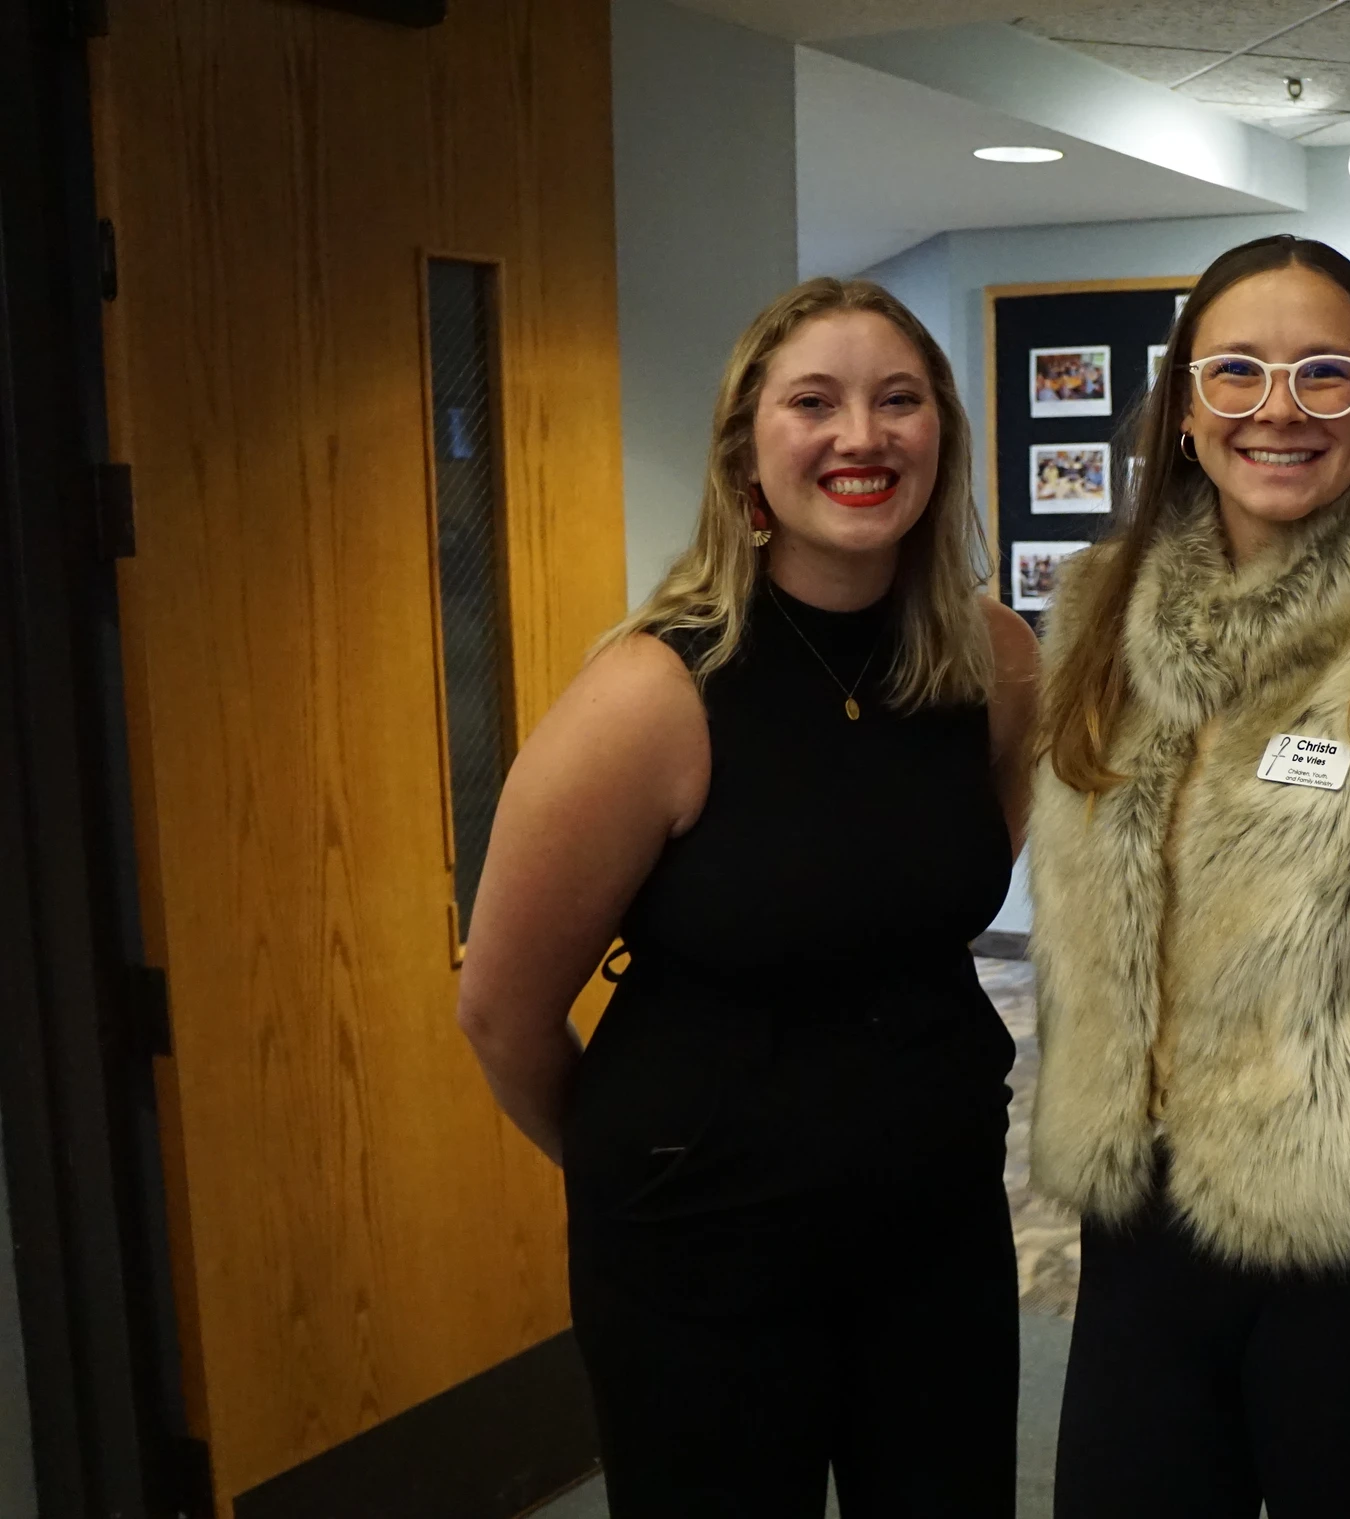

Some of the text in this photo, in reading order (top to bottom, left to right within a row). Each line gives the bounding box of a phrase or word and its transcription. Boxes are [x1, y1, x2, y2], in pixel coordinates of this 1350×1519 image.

[1296, 740, 1338, 755] Christa
[1292, 754, 1326, 766] De Vries
[1297, 776, 1314, 785] Family
[1314, 779, 1334, 788] Ministry
